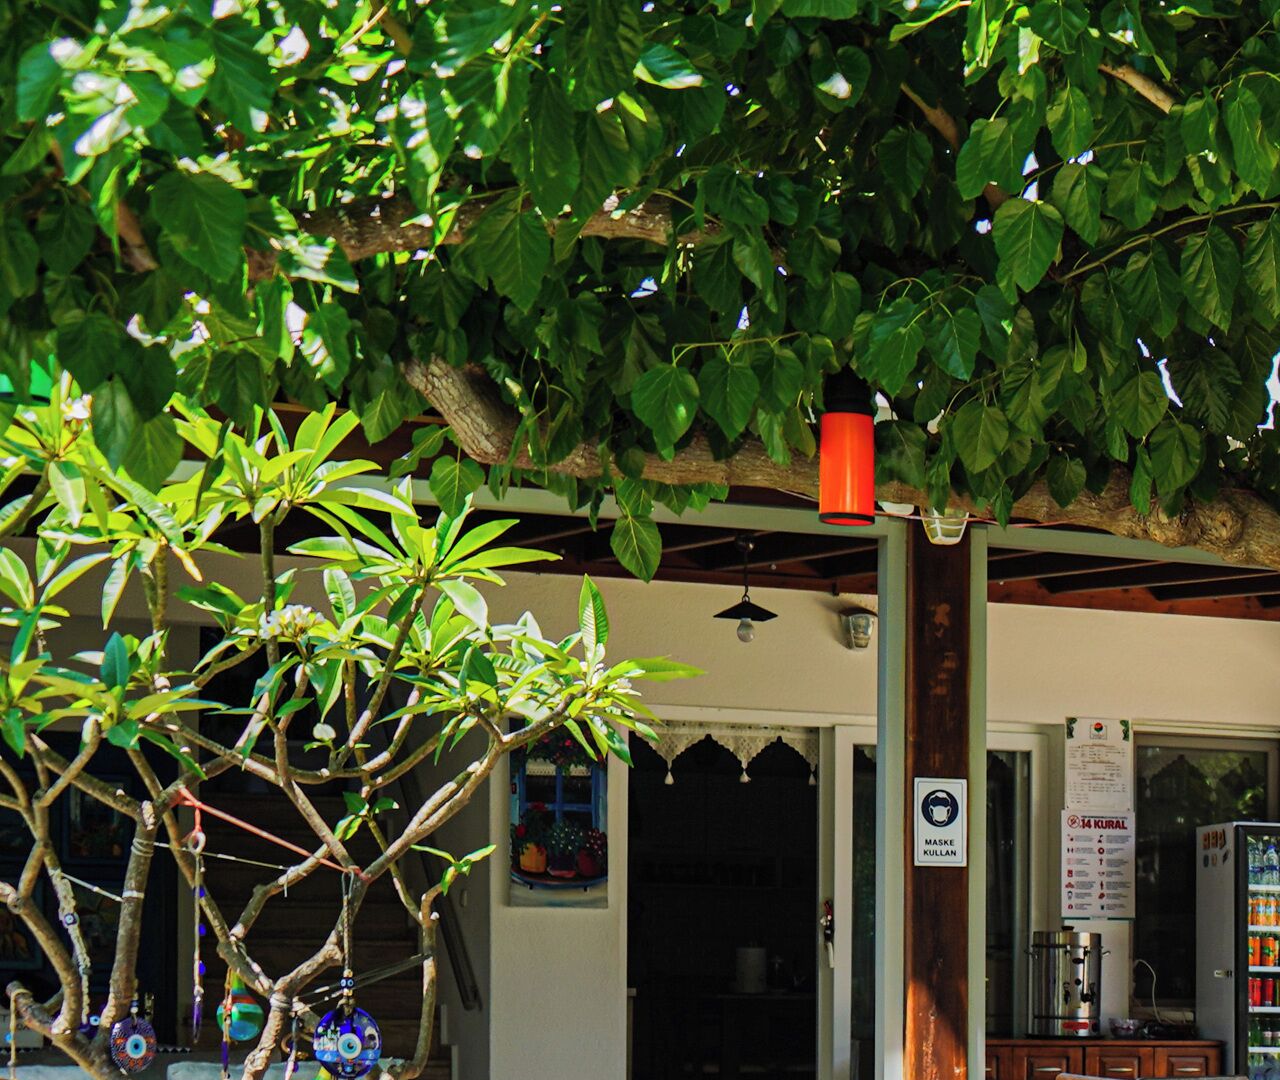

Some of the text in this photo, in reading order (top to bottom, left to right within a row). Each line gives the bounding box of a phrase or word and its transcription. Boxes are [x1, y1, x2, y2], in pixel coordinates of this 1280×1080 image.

[1081, 819, 1128, 830] 14 KURAL
[925, 839, 955, 847] MASKE
[923, 849, 957, 857] KULLAN
